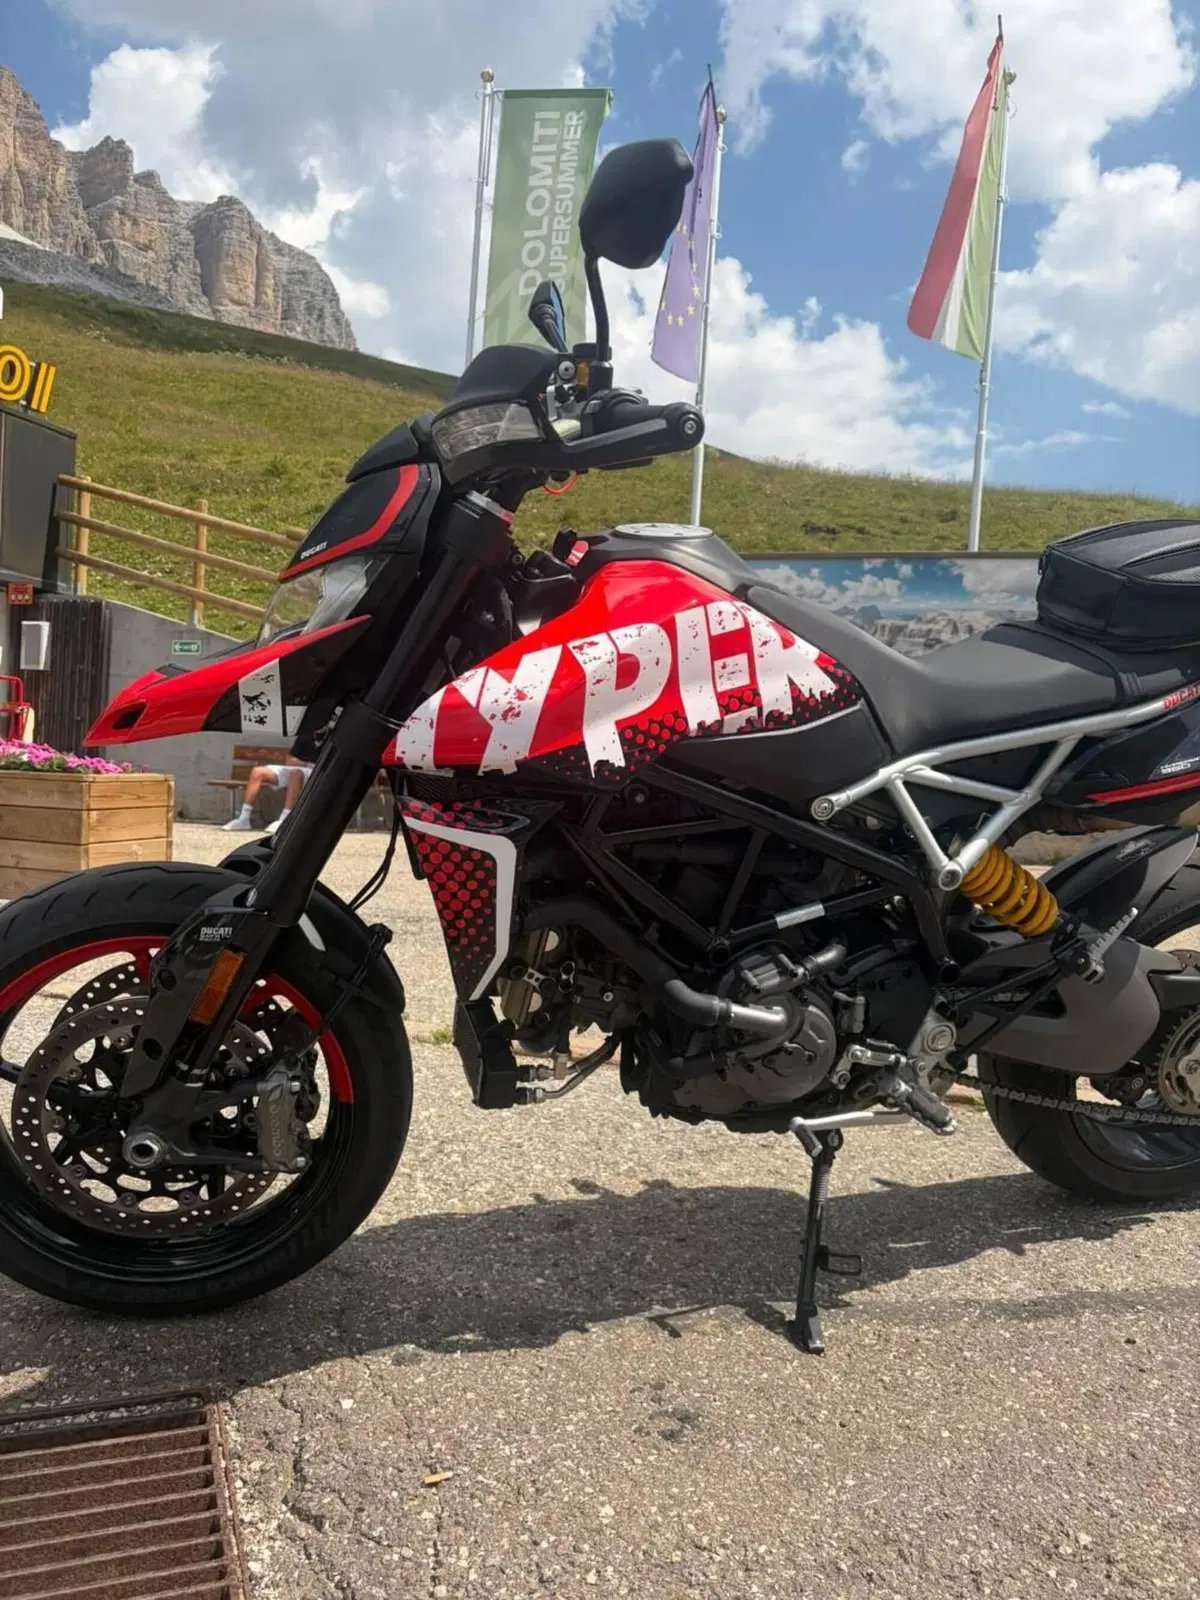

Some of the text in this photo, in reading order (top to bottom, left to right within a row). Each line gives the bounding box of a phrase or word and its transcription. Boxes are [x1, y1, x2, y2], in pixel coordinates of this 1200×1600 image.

[519, 111, 561, 296] DOLOMITI
[547, 108, 584, 295] SUPERSUMMER
[200, 927, 233, 936] DUCATI
